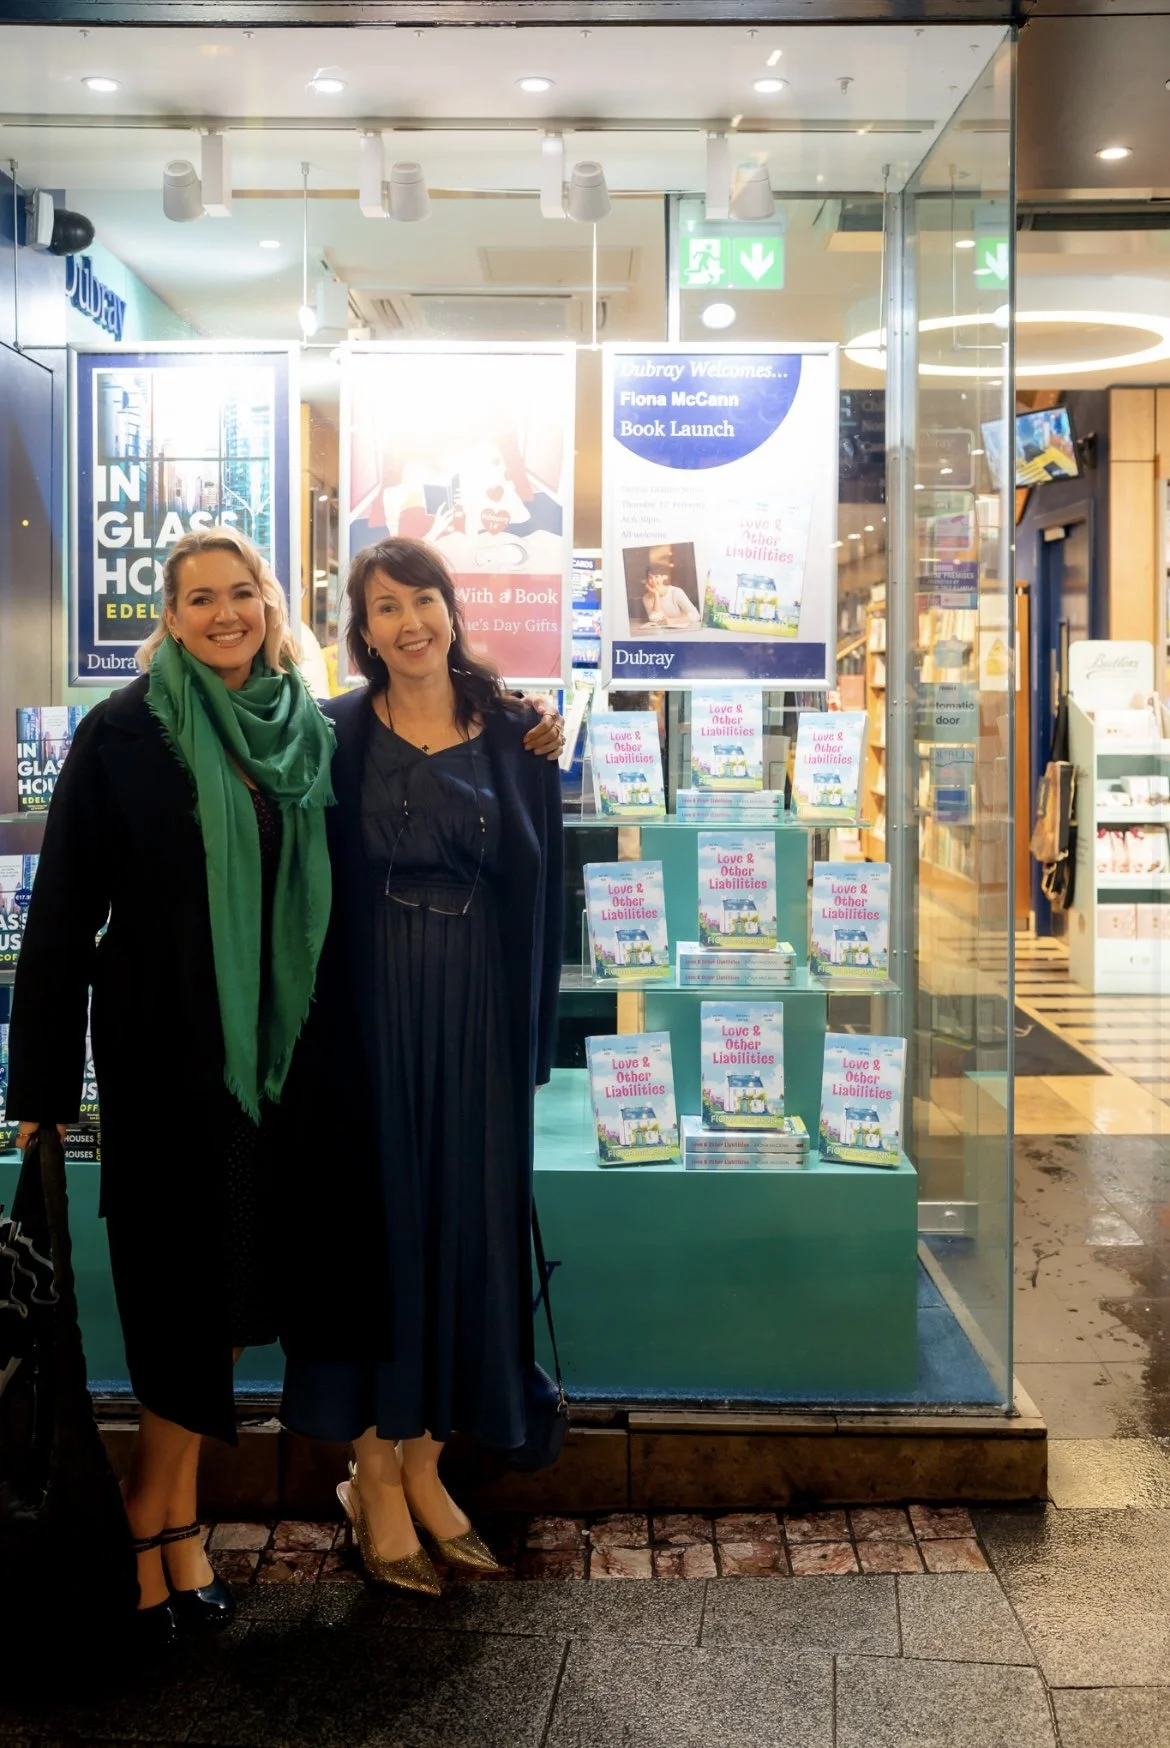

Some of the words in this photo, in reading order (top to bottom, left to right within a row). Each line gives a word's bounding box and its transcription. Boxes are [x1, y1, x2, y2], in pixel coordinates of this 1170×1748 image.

[621, 360, 684, 381] Dubray
[690, 361, 788, 378] Welcomes...
[620, 392, 666, 406] Fiona
[671, 392, 739, 406] McCann
[620, 421, 666, 437] Book
[670, 420, 735, 437] Launch
[97, 465, 140, 502] IN
[742, 531, 781, 546] Other
[725, 544, 794, 564] Liabilities
[455, 587, 493, 604] With
[500, 592, 509, 604] a
[515, 588, 558, 604] Book
[106, 604, 160, 619] EDEL
[494, 620, 521, 634] Day
[525, 620, 558, 632] Gifts
[615, 650, 675, 669] Dubray
[709, 704, 733, 714] Love
[736, 703, 743, 713] &
[712, 715, 743, 725] Other
[936, 715, 960, 725] door
[610, 732, 632, 741] Love
[634, 731, 641, 740] &
[701, 726, 754, 736] Liabilities
[813, 732, 834, 741] Love
[837, 731, 843, 741] &
[17, 743, 37, 758] IN
[614, 742, 642, 752] Other
[814, 743, 843, 753] Other
[605, 753, 654, 764] Liabilities
[804, 754, 852, 764] Liabilities
[17, 760, 65, 776] GLAS
[18, 778, 57, 795] HOU
[717, 854, 743, 864] Love
[747, 853, 754, 863] &
[721, 866, 754, 876] Other
[608, 884, 633, 894] Love
[636, 882, 644, 893] &
[709, 878, 767, 889] Liabilities
[831, 884, 856, 894] Love
[860, 884, 868, 894] &
[612, 896, 645, 907] Other
[834, 896, 867, 907] Other
[601, 908, 658, 920] Liabilities
[822, 908, 880, 920] Liabilities
[0, 913, 28, 930] ASS
[0, 953, 17, 961] COF
[722, 1025, 749, 1036] Love
[753, 1025, 760, 1036] &
[726, 1039, 761, 1050] Other
[612, 1058, 638, 1070] Love
[643, 1056, 650, 1067] &
[713, 1052, 774, 1064] Liabilities
[843, 1058, 869, 1069] Love
[873, 1059, 880, 1070] &
[617, 1071, 651, 1083] Other
[845, 1071, 880, 1084] Other
[605, 1084, 665, 1098] Liabilities
[833, 1084, 892, 1099] Liabilities
[79, 1104, 98, 1112] OFF
[64, 1134, 94, 1143] HOUSES
[65, 1150, 93, 1158] HOUSES
